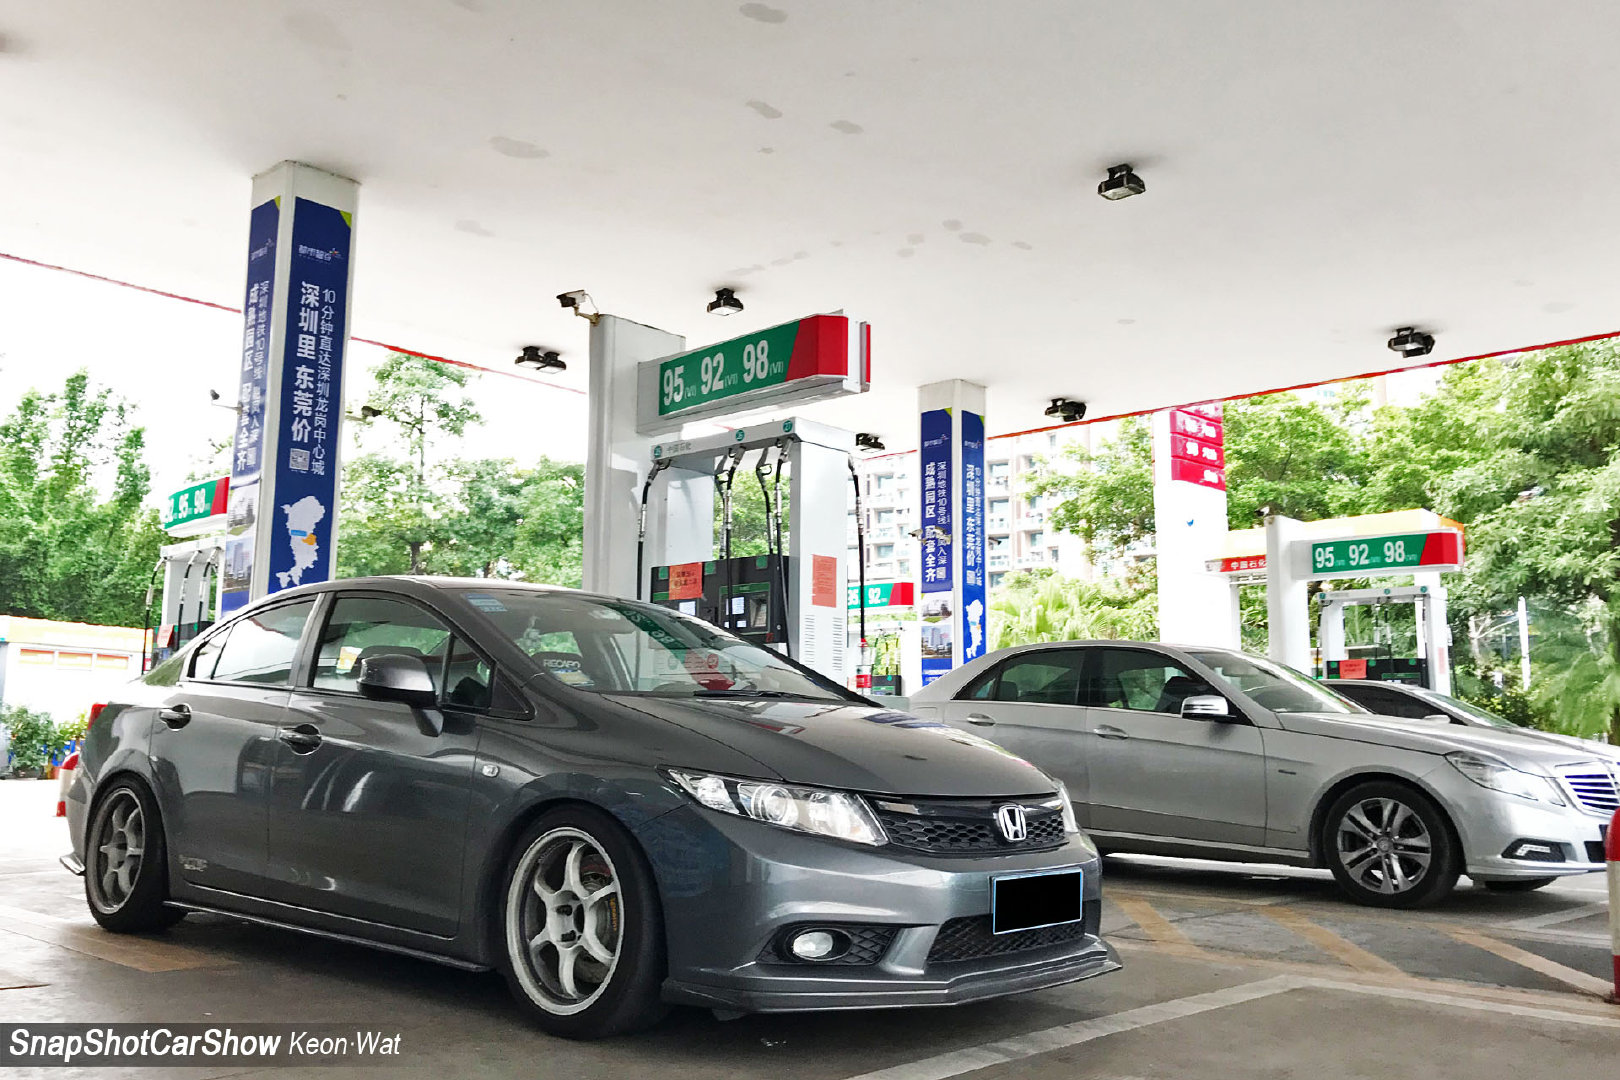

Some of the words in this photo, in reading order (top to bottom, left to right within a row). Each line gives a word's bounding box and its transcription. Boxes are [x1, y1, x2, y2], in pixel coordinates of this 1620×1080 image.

[297, 281, 319, 360] 深圳里
[291, 365, 315, 443] 东莞价
[311, 288, 336, 475] 10分钟直达深圳龙岗中心城
[663, 365, 685, 406] 95
[701, 352, 724, 394] 92
[743, 340, 769, 383] 98
[1315, 546, 1335, 568] 95
[1349, 543, 1369, 566] 92
[1384, 541, 1405, 562] 98
